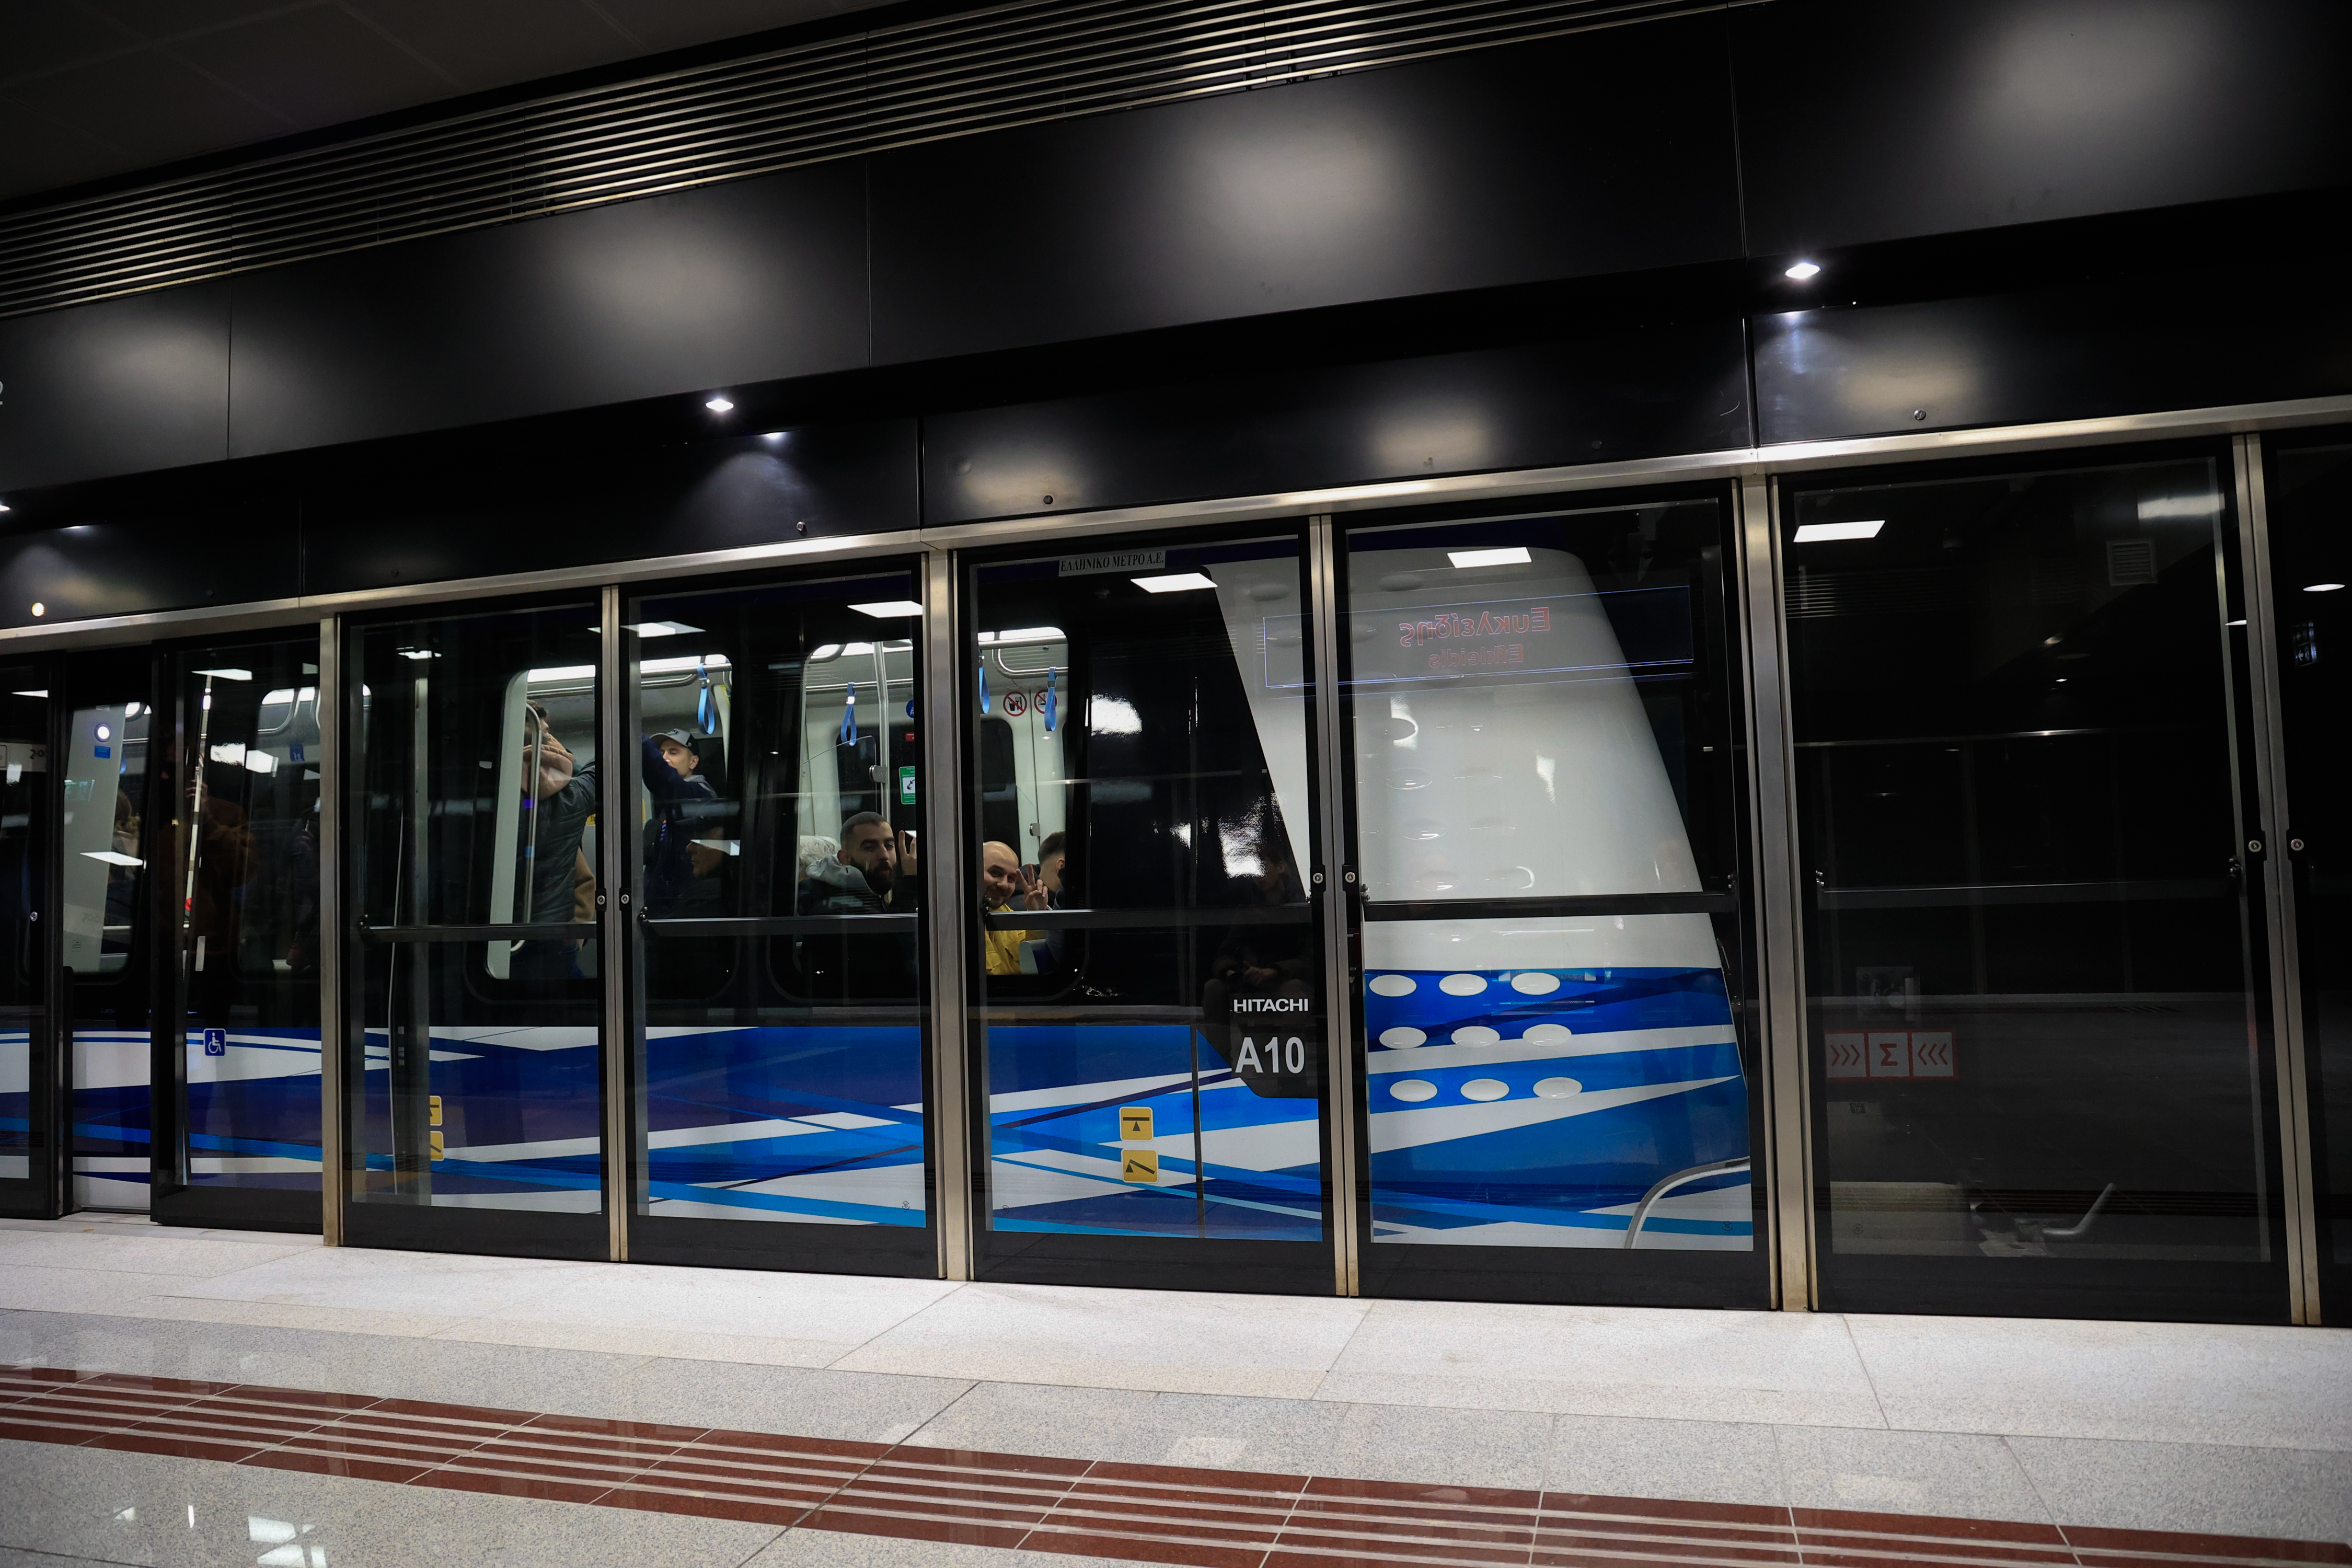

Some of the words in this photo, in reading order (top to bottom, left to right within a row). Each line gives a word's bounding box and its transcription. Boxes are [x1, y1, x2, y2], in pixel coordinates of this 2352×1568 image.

[1060, 557, 1110, 572] ΕΛΛΗΝΙΚΟ
[1112, 554, 1145, 568] ΜΕΤΡΟ
[1146, 552, 1165, 564] Α.Ε.
[1233, 998, 1309, 1012] HITACHI
[1235, 1036, 1305, 1074] A10
